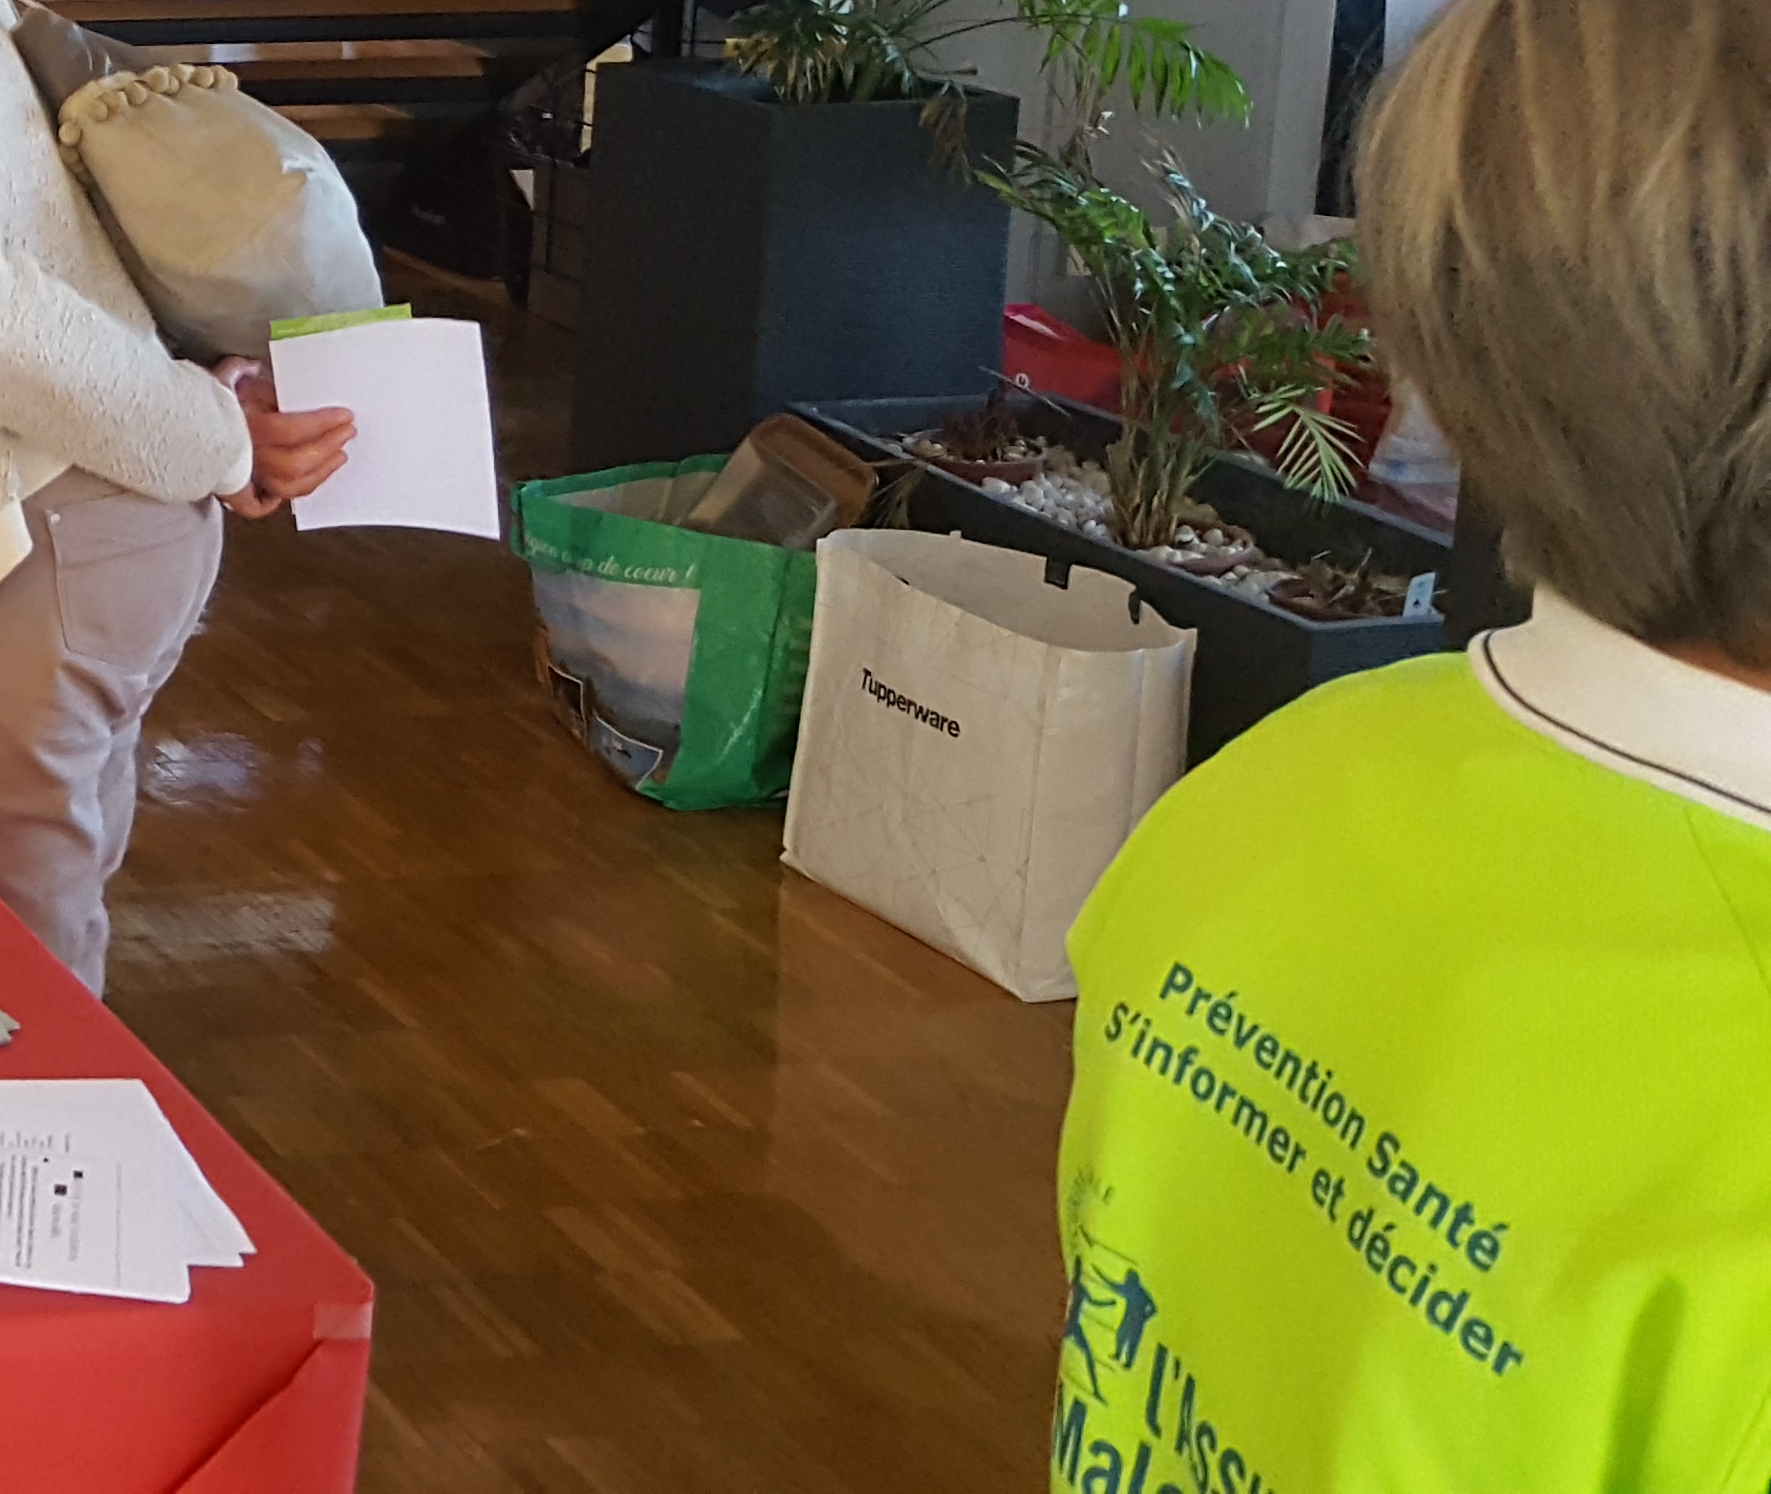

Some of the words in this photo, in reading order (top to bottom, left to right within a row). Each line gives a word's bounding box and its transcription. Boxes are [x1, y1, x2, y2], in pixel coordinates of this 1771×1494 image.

[861, 667, 961, 738] Tupperware
[1104, 1001, 1307, 1173] S'informer
[1311, 1167, 1346, 1224] et
[1346, 1206, 1525, 1378] décider
[1159, 961, 1367, 1151] Prévention
[1366, 1131, 1509, 1273] Santé
[1055, 1396, 1183, 1494] Mal
